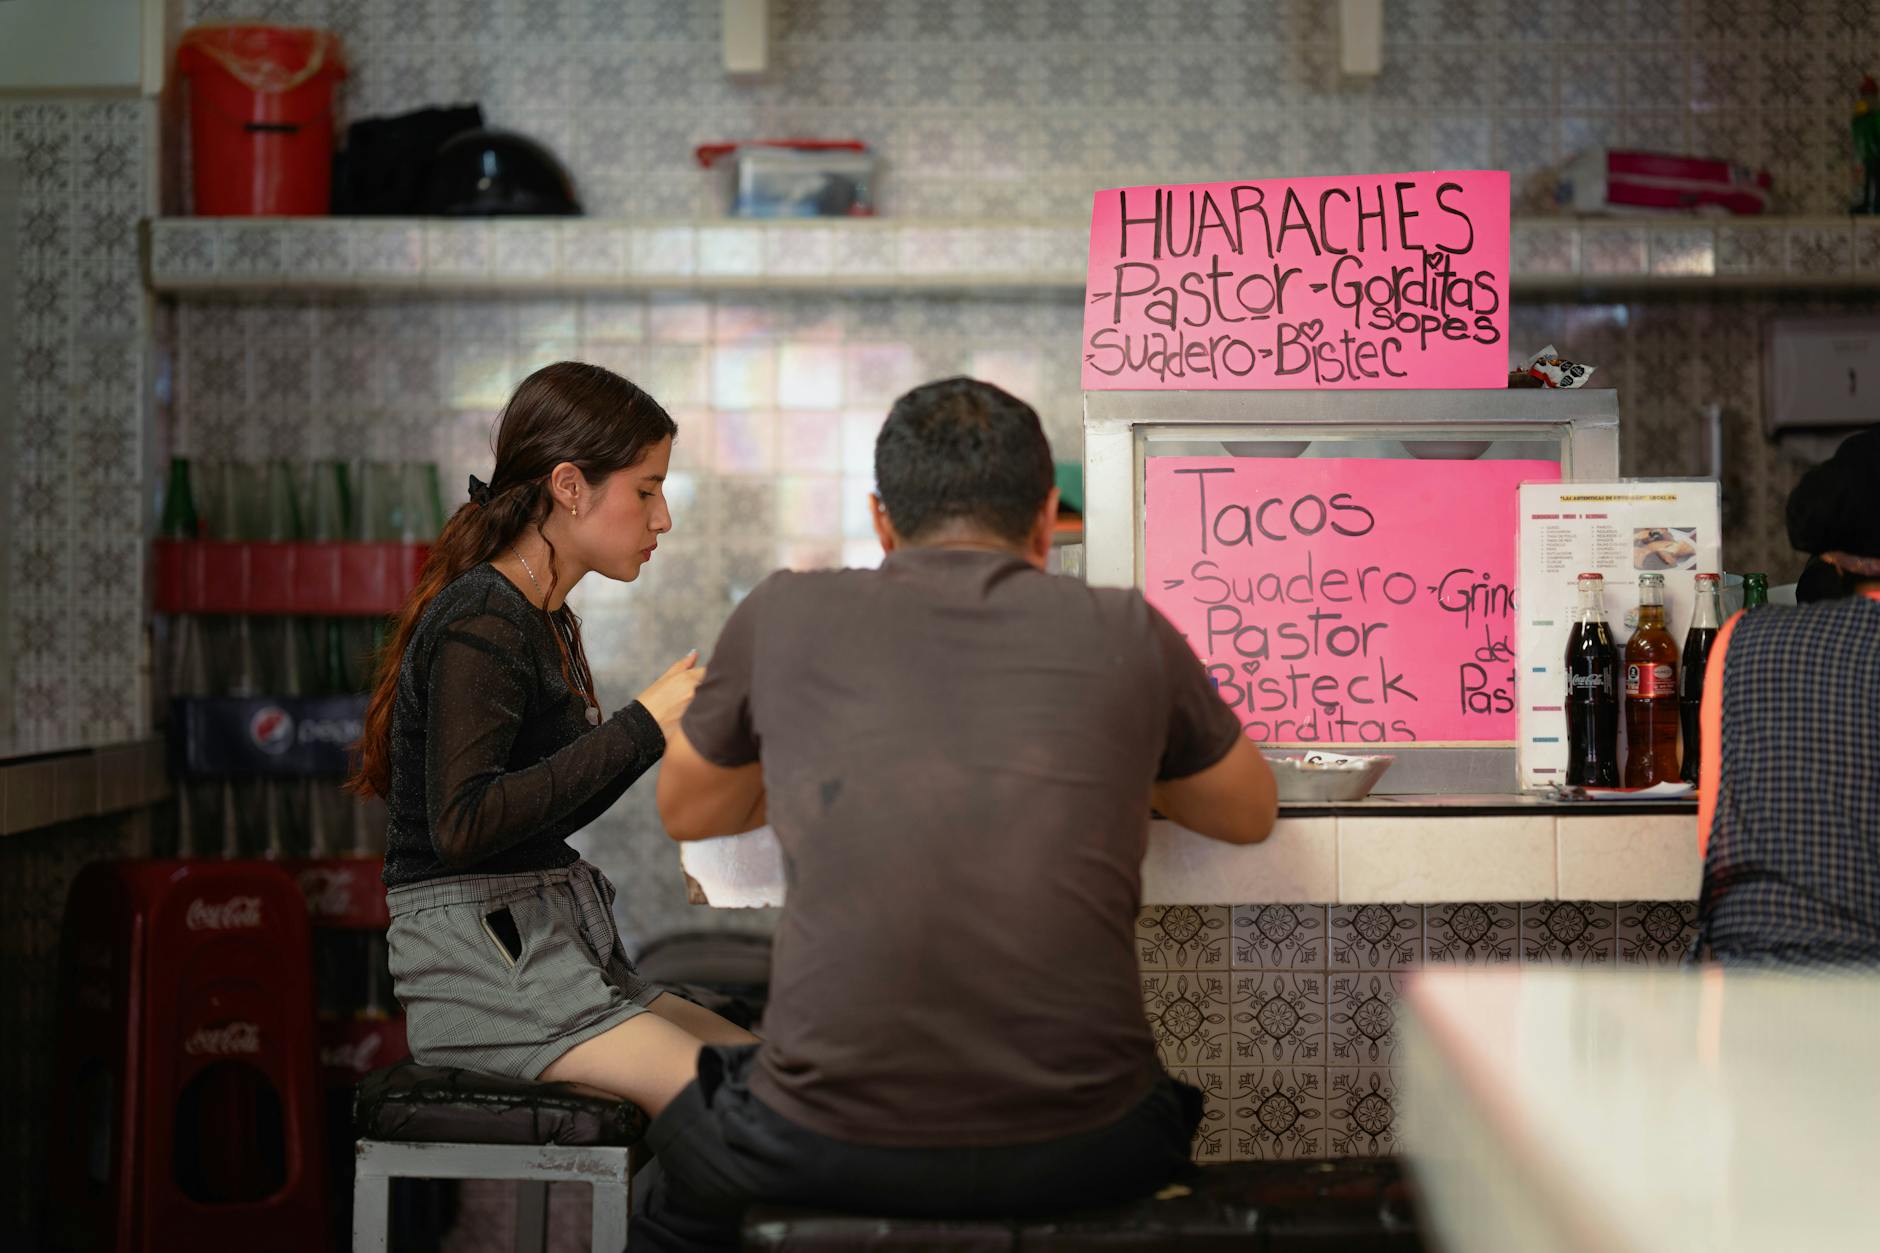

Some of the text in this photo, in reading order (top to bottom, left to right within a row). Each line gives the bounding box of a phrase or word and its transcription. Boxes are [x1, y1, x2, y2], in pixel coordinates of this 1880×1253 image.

[1120, 181, 1474, 260] HUARACHES
[1367, 306, 1501, 351] sopes
[1173, 467, 1375, 554] Tacos
[1190, 550, 1417, 606] Suadero
[1207, 606, 1389, 661] Pastor
[1206, 656, 1418, 713] Bisteck
[1242, 704, 1416, 743] orditas
